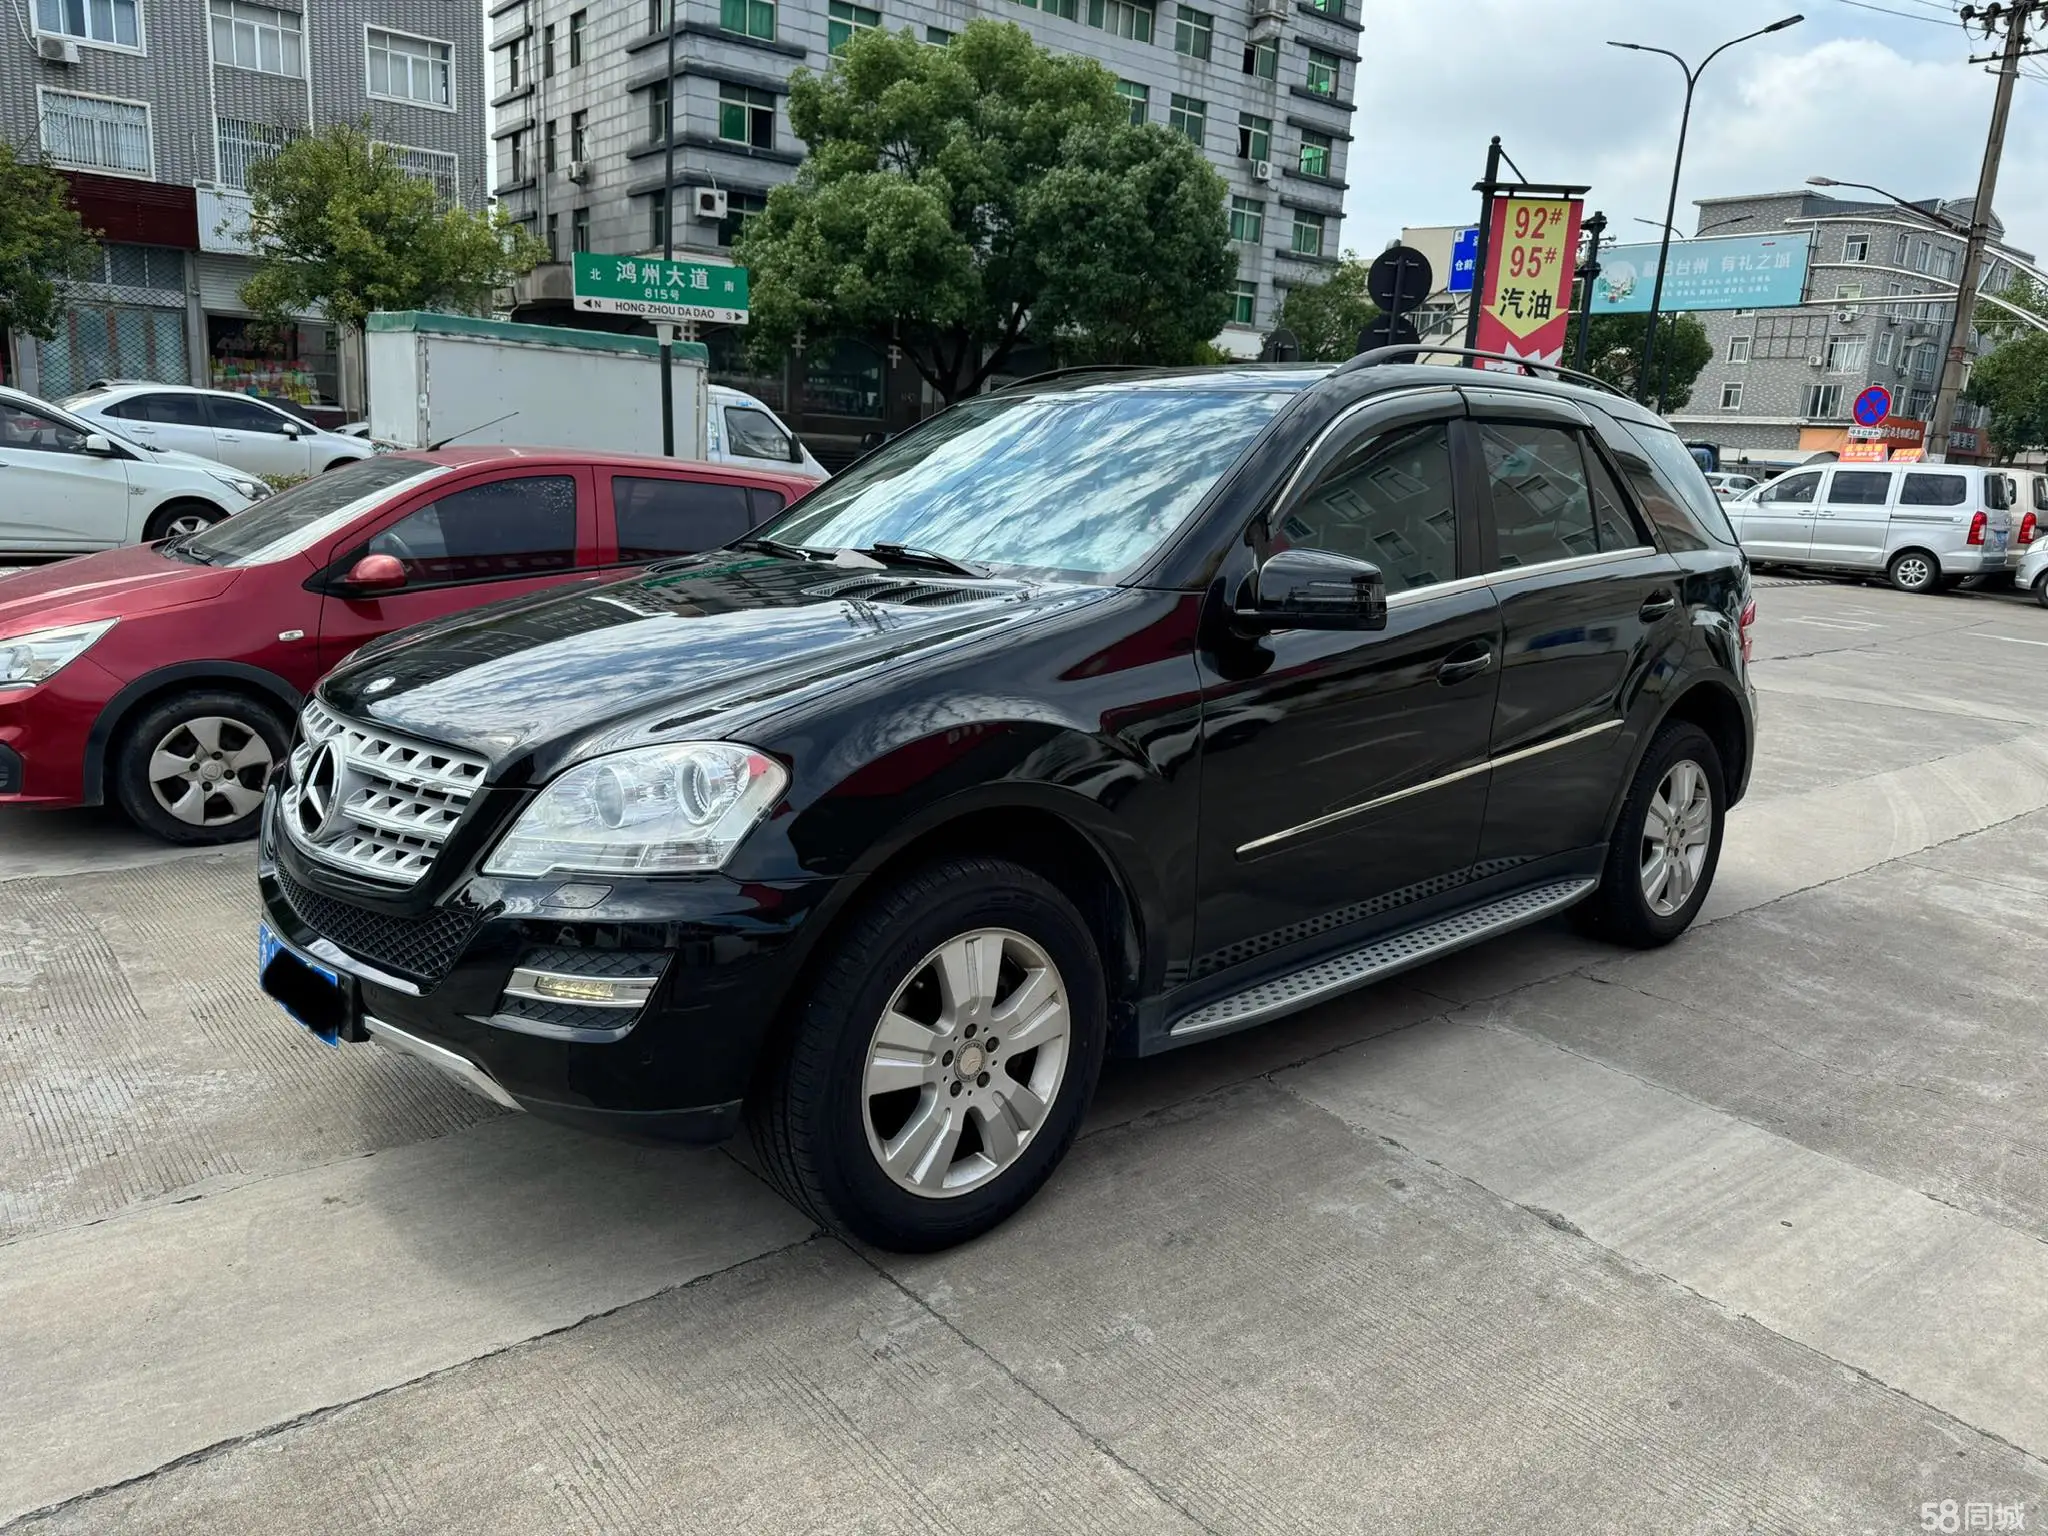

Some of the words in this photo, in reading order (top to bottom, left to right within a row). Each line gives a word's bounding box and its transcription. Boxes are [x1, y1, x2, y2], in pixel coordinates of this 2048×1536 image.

[1514, 206, 1563, 239] 92#
[590, 268, 602, 281] 北
[616, 261, 710, 290] 鸿州大道
[724, 280, 735, 293] 南
[1509, 245, 1557, 278] 95#
[594, 300, 602, 308] N
[615, 301, 646, 313] HONG
[648, 304, 676, 315] ZHOU
[678, 306, 692, 316] DA
[693, 308, 715, 319] DAO
[726, 312, 732, 320] S
[644, 288, 680, 301] 815号
[1499, 288, 1553, 320] 汽油
